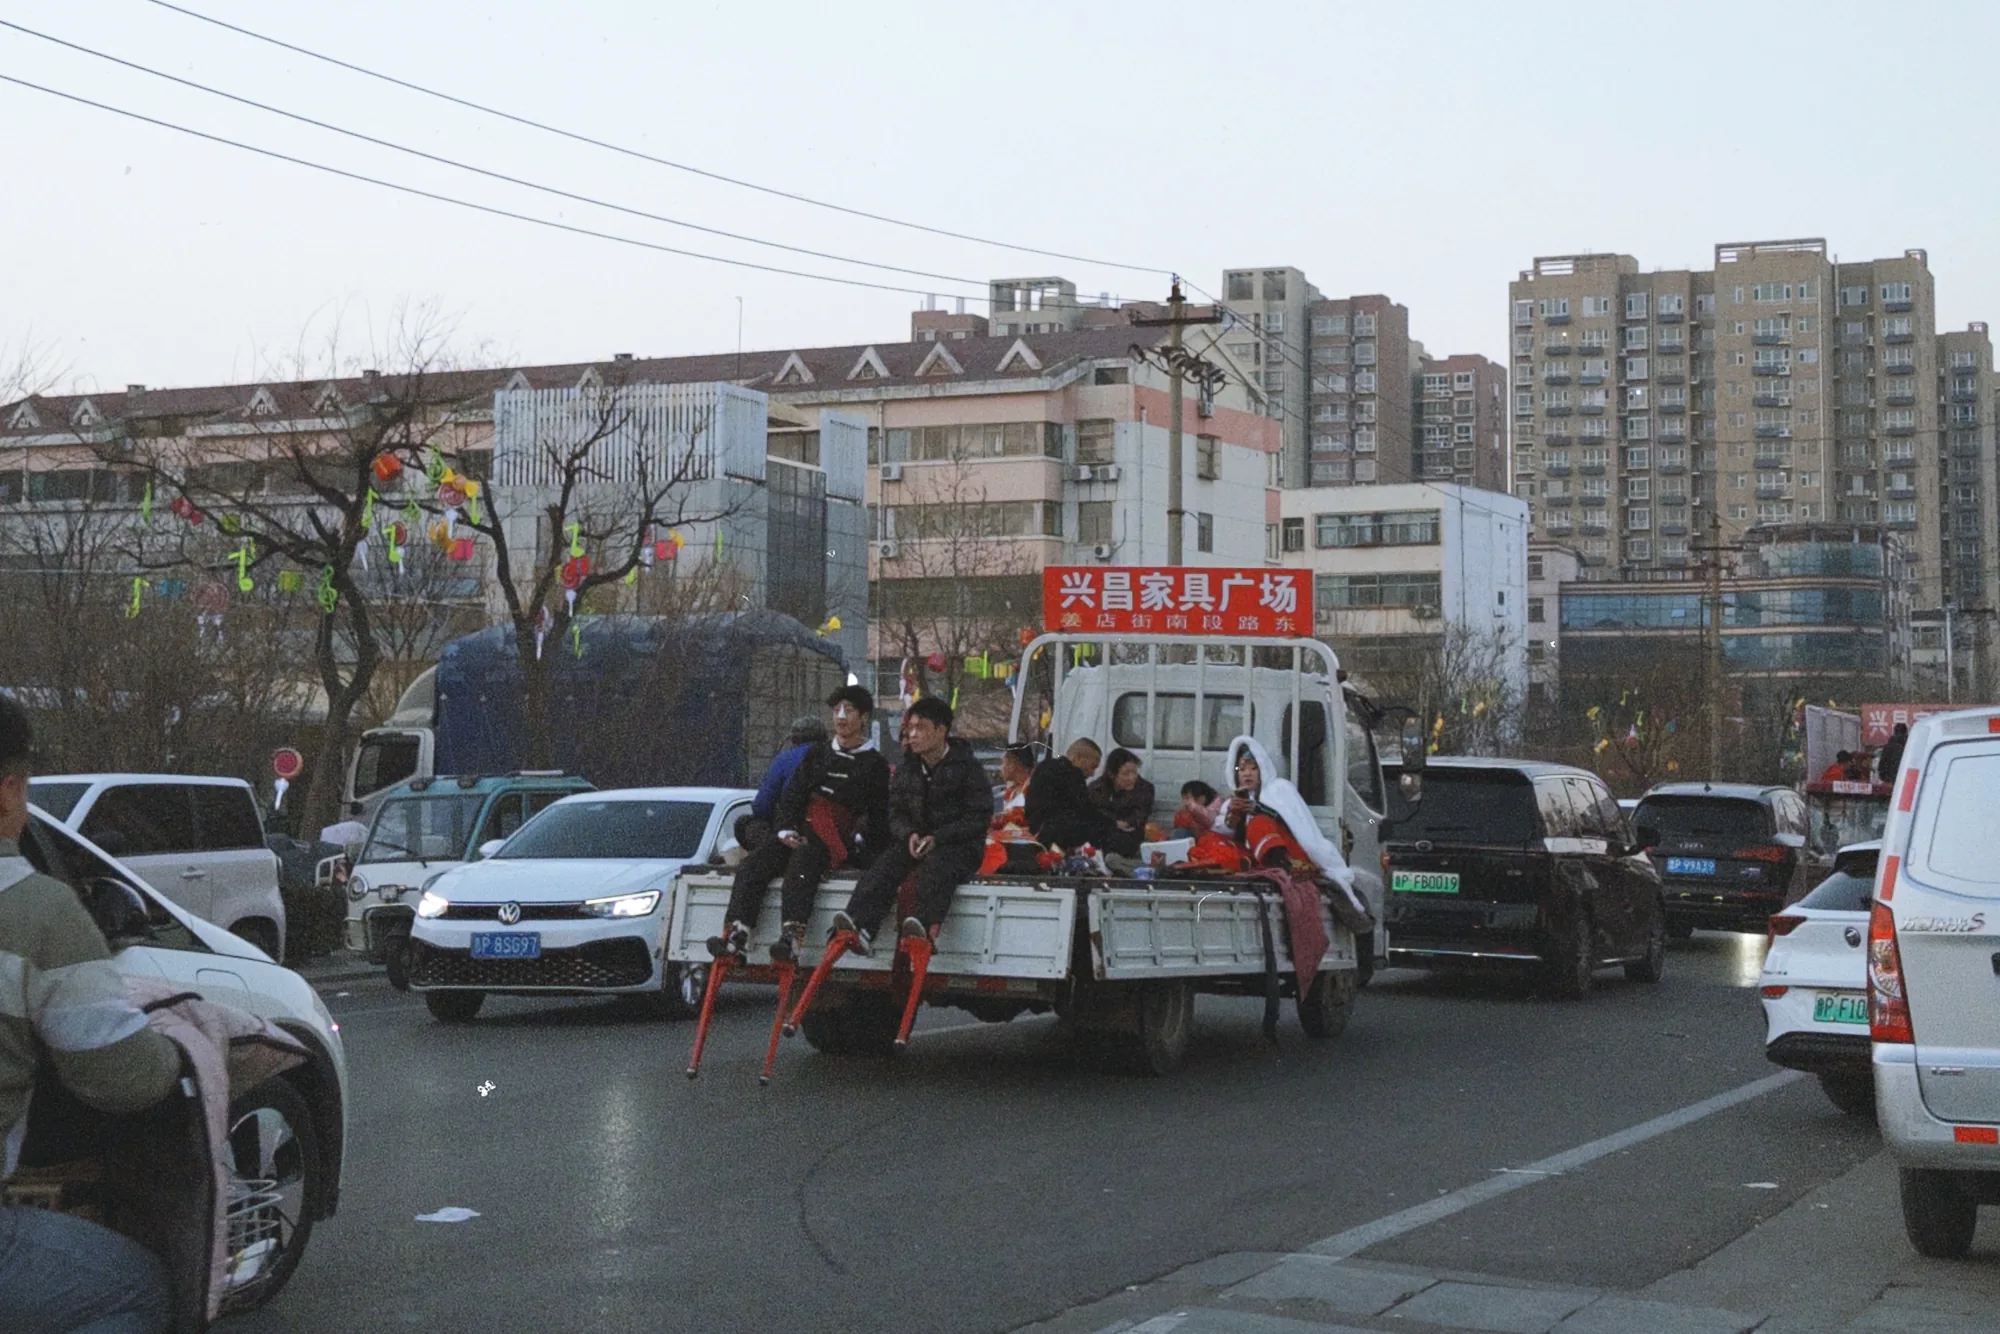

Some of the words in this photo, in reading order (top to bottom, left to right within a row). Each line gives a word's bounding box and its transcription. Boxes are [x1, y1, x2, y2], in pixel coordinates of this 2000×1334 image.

[1060, 571, 1298, 613] 兴昌家具广场
[1868, 710, 1931, 737] 兴昌
[1839, 998, 1869, 1020] F10
